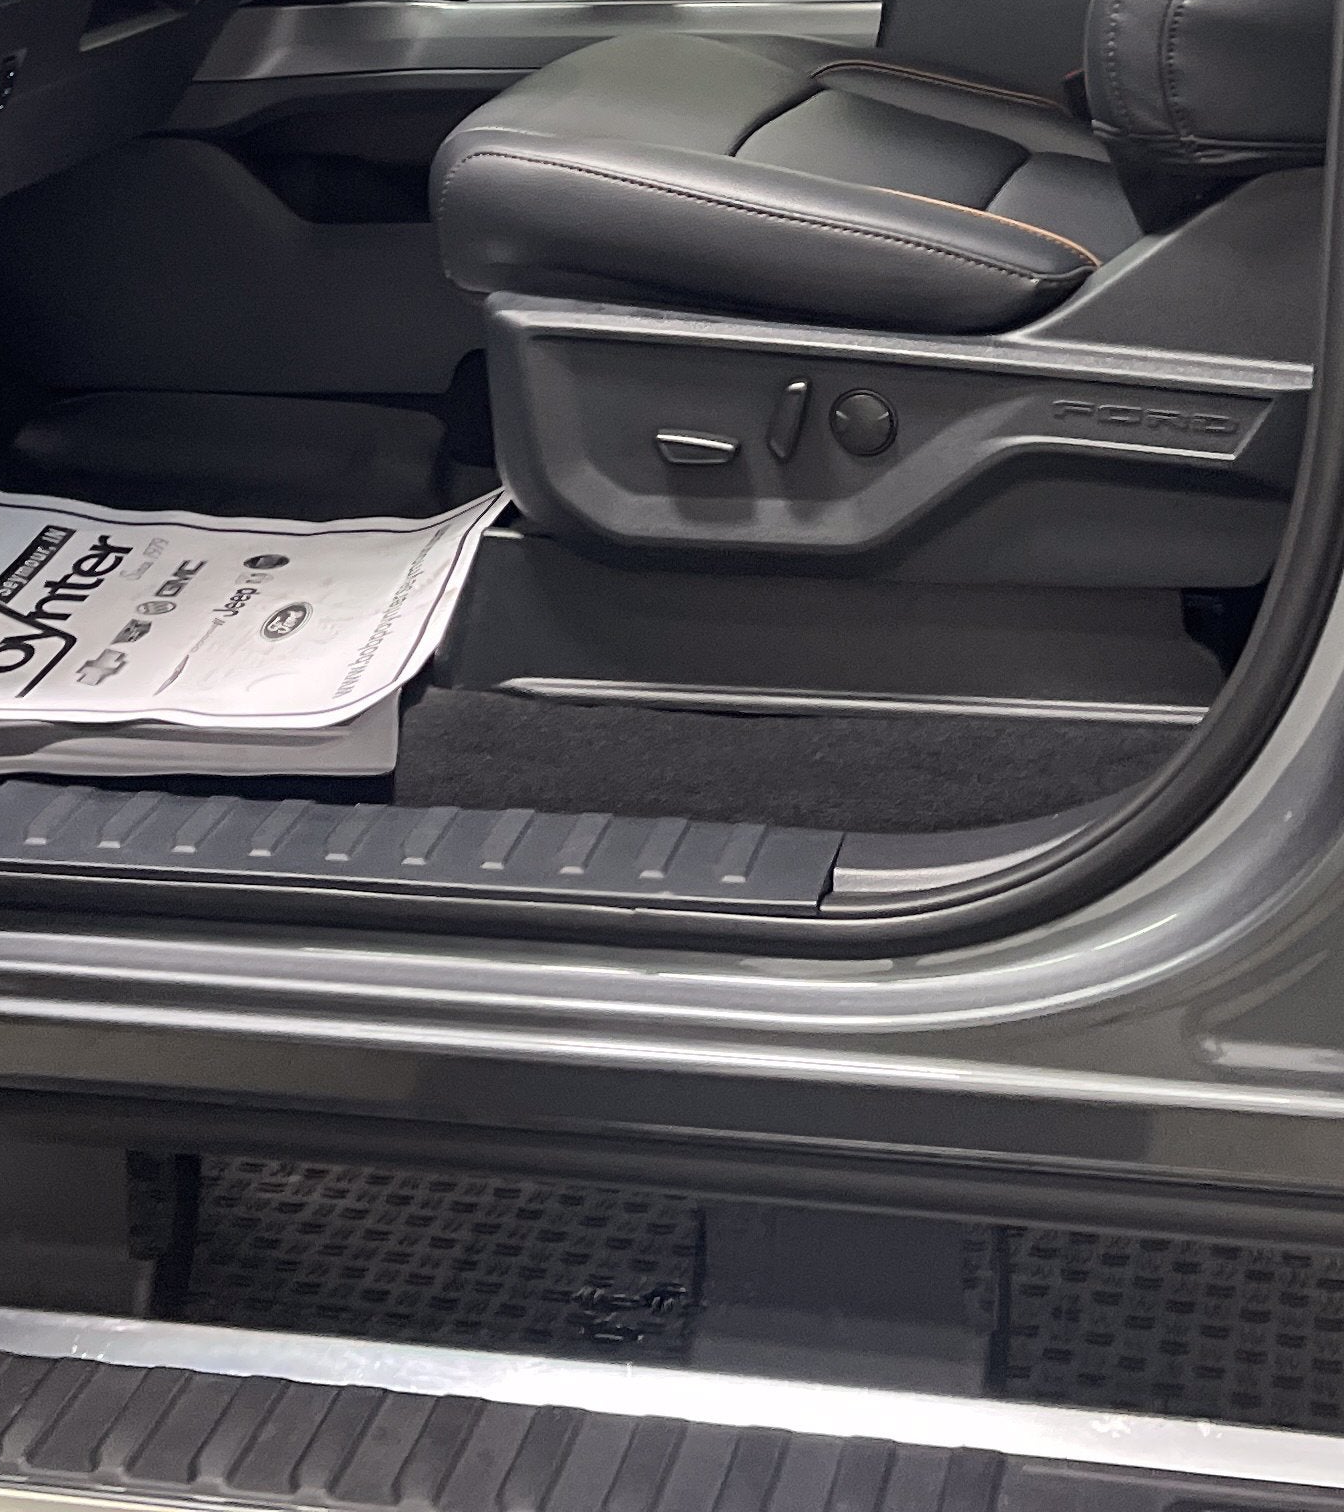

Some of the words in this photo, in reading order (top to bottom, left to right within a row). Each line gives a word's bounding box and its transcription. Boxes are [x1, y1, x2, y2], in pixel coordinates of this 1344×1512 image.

[1051, 399, 1240, 434] FORD
[154, 559, 208, 597] GMC
[212, 587, 261, 618] Jeep
